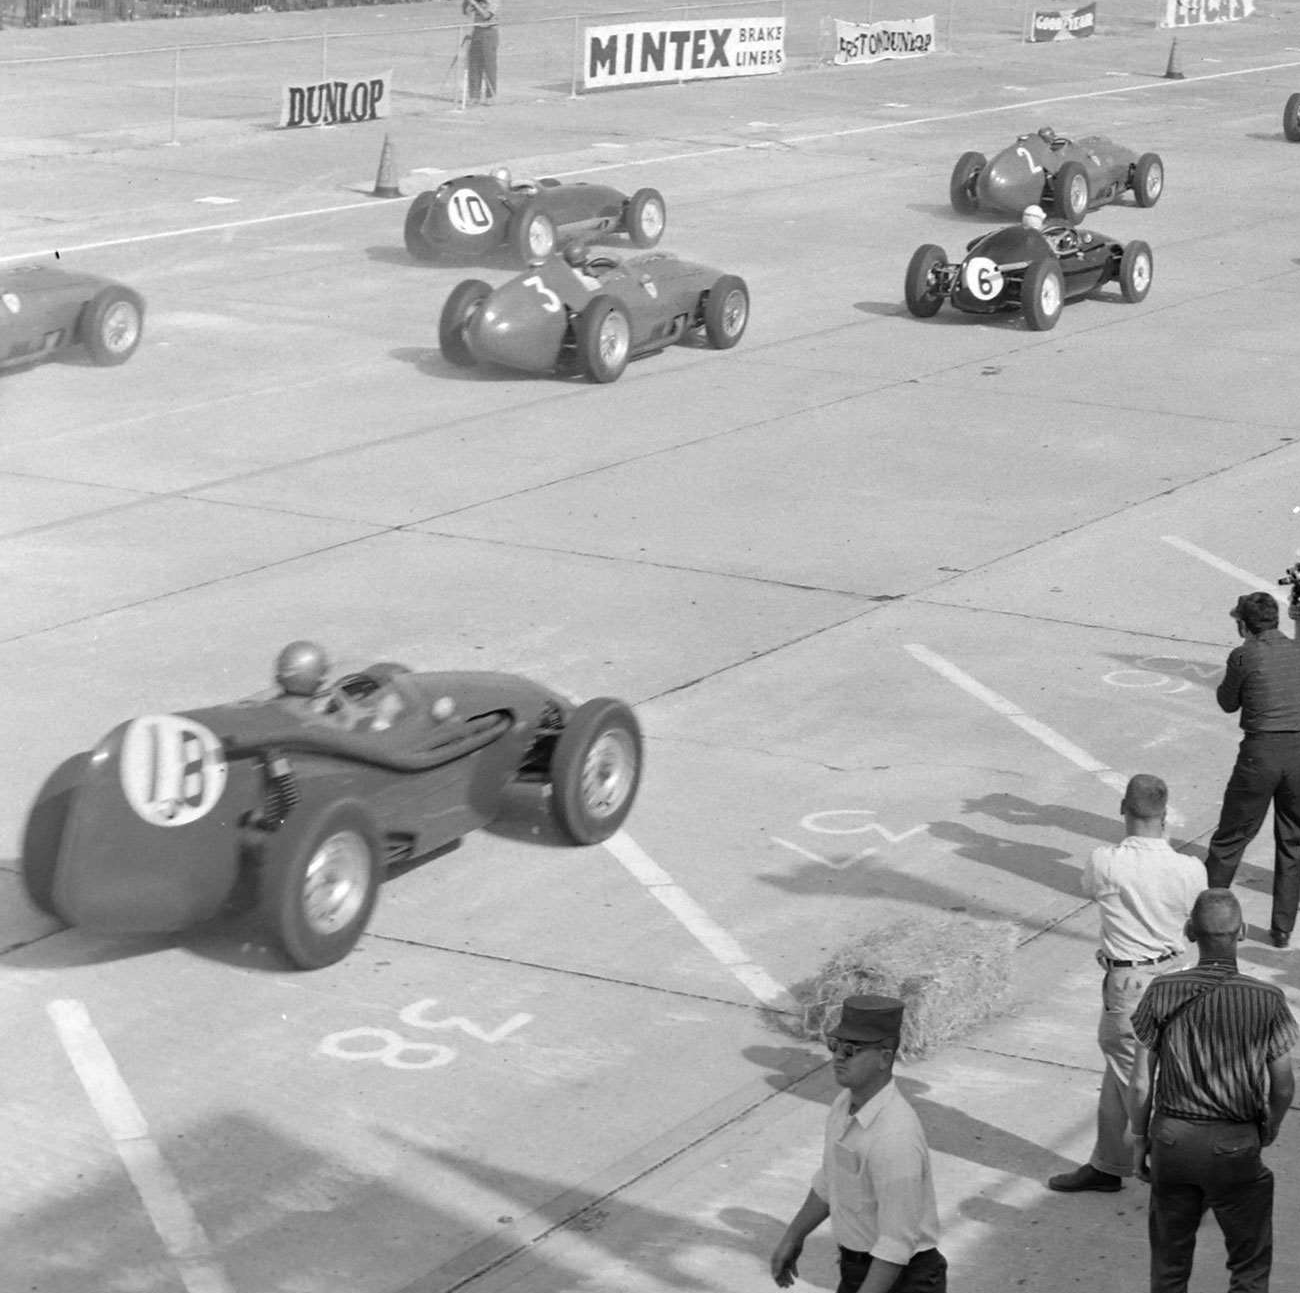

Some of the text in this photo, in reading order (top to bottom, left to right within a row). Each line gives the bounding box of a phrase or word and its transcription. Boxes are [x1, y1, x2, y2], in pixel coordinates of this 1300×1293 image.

[739, 26, 783, 43] BRAKE
[590, 28, 732, 78] MINTEX
[736, 49, 782, 67] LINERS
[287, 79, 384, 126] DUNLOP
[1016, 146, 1042, 174] 2
[453, 195, 490, 227] 10
[522, 275, 562, 313] 3
[977, 267, 993, 295] 6
